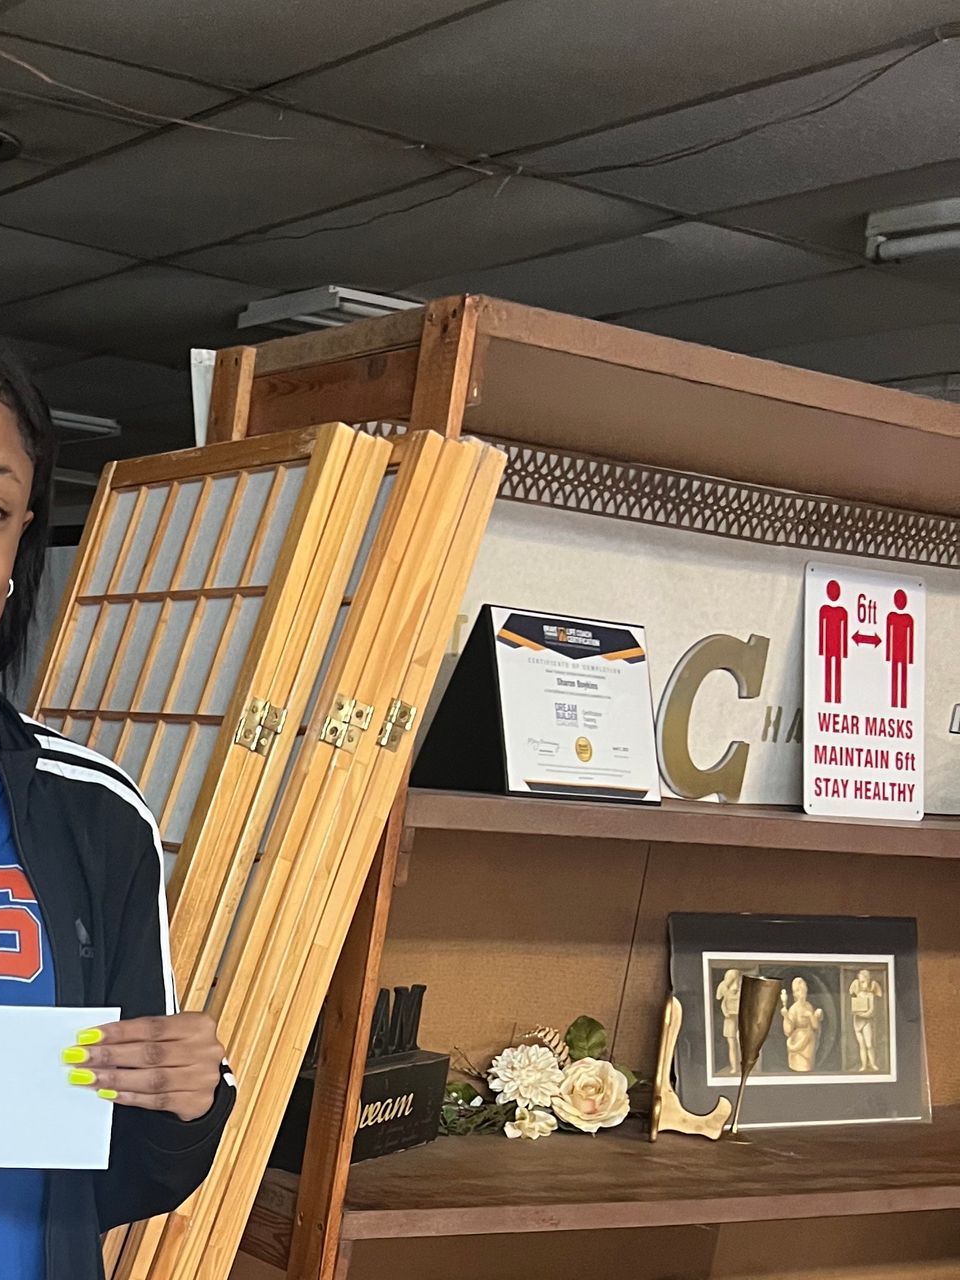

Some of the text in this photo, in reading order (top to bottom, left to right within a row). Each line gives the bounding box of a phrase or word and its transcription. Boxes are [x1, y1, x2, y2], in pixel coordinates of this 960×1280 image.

[857, 593, 878, 625] 6ft
[554, 702, 577, 713] DREAM
[818, 711, 914, 740] WEAR MASKS
[814, 744, 916, 772] MAINTAIN 6ft
[814, 777, 916, 803] STAY HEALTHY
[354, 1092, 414, 1137] ream
